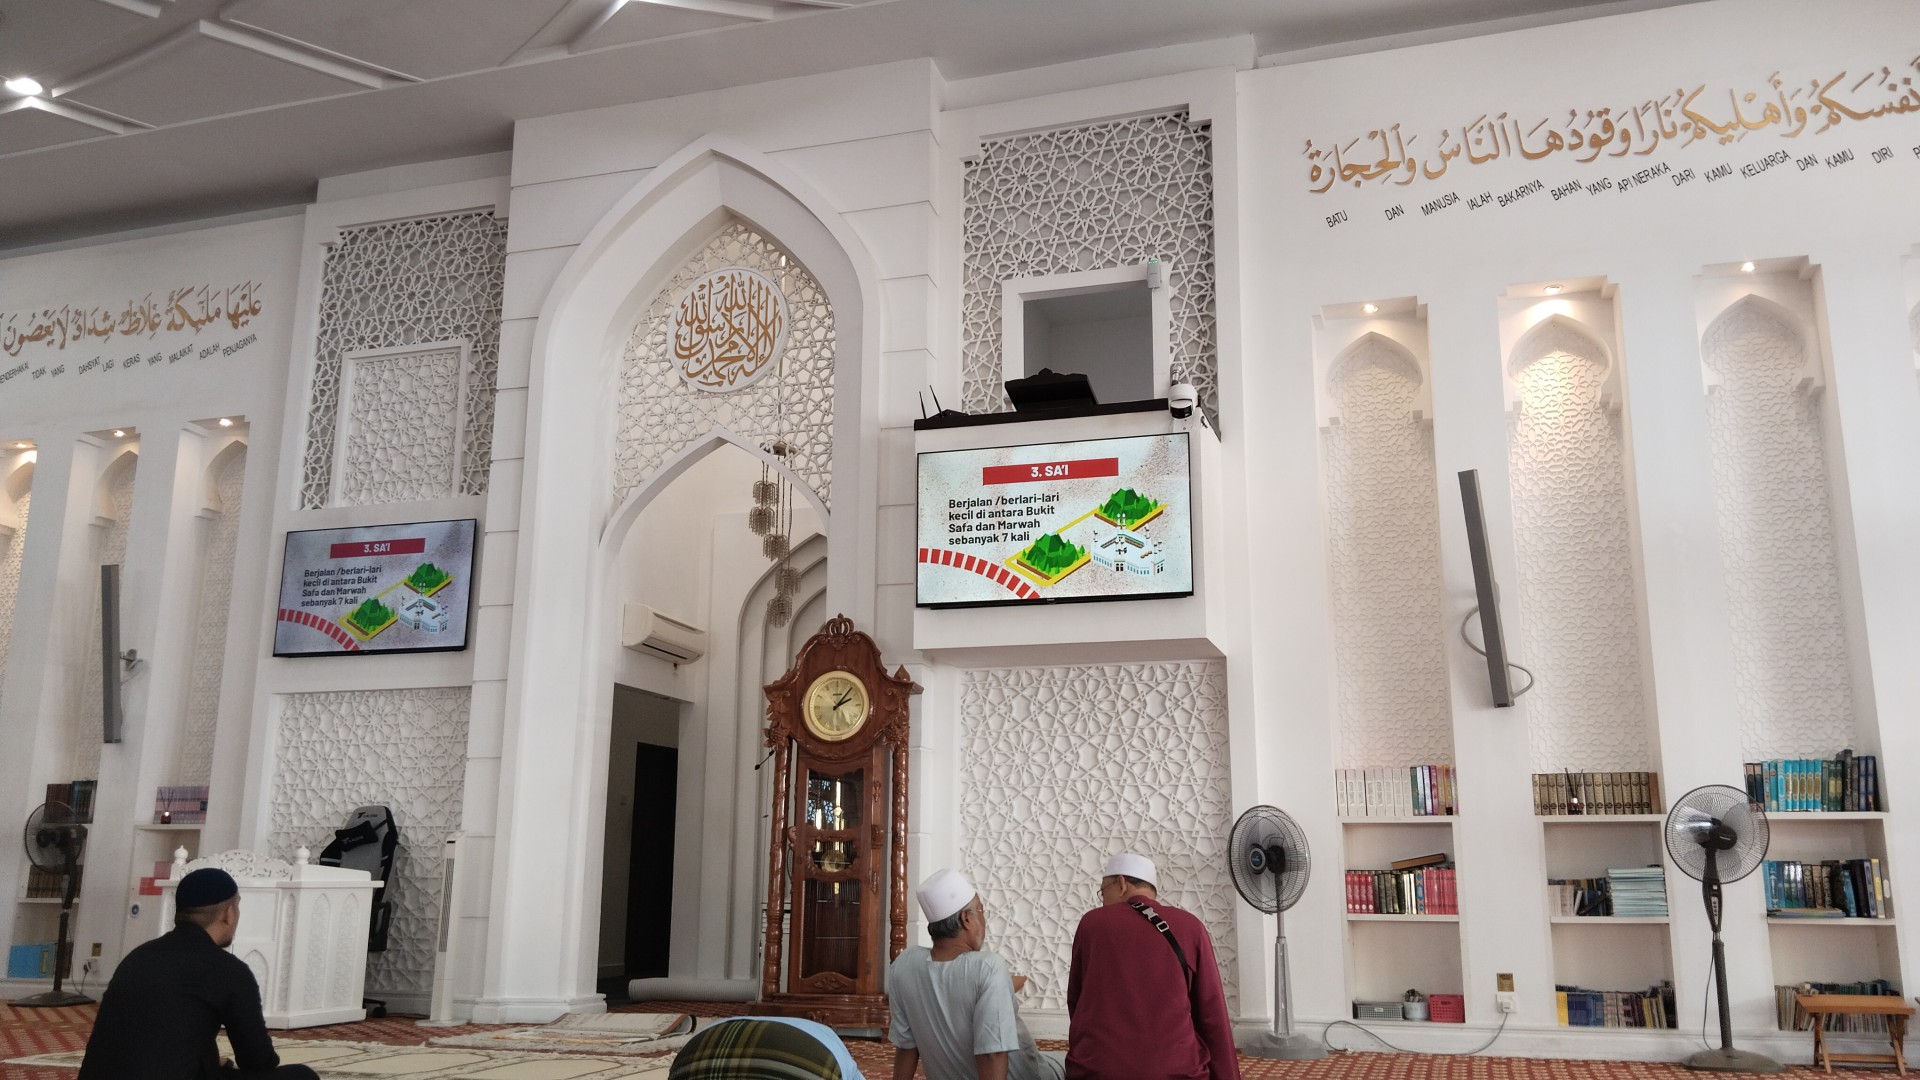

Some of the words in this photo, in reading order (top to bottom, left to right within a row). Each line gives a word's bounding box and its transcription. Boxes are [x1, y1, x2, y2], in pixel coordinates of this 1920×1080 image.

[1325, 210, 1348, 228] BATU
[1384, 204, 1405, 221] DAN
[1421, 191, 1461, 216] MANUSIA
[1466, 191, 1494, 211] IALAH
[1497, 179, 1545, 208] BAKARNYA
[1550, 179, 1582, 201] BAHAN
[1585, 177, 1613, 196] YANG
[1616, 177, 1634, 193] API
[1631, 161, 1672, 185] NERAKA
[1671, 168, 1696, 187] DARI
[1703, 162, 1733, 183] KAMU
[1740, 149, 1791, 179] KELUARGA
[1795, 153, 1819, 172] DAN
[1824, 148, 1855, 169] KAMU
[1871, 146, 1894, 164] DIRI
[0, 361, 29, 384] ENDERHAKAI
[31, 366, 47, 380] TIDAK
[50, 364, 66, 378] YANG
[78, 356, 101, 375] DAHSYAT
[102, 359, 115, 372] LAGI
[122, 353, 141, 370] KERAS
[147, 352, 163, 366] YANG
[168, 343, 194, 364] MALAIKAT
[199, 342, 221, 361] ADALAH
[222, 333, 258, 357] PENJAGANYA
[1031, 466, 1042, 478] 3.
[949, 498, 992, 510] Berjalan
[949, 510, 974, 521] kecil
[976, 509, 986, 519] di
[988, 509, 1024, 519] antara
[1026, 505, 1055, 516] Bukit
[949, 523, 973, 533] Safa
[975, 522, 995, 531] dan
[998, 519, 1041, 530] Marwah
[948, 534, 1000, 545] sebanyak
[1002, 533, 1009, 542] 7
[1010, 531, 1030, 542] kali
[363, 544, 372, 553] 3.
[304, 568, 336, 578] Berjalan
[303, 579, 321, 587] kecil
[322, 578, 330, 586] di
[330, 578, 356, 586] antara
[357, 575, 378, 584] Bukit
[302, 589, 319, 597] Safa
[320, 588, 336, 596] dan
[336, 586, 367, 595] Marwah
[301, 598, 337, 607] sebanyak
[338, 597, 343, 605] 7
[344, 596, 359, 605] kali
